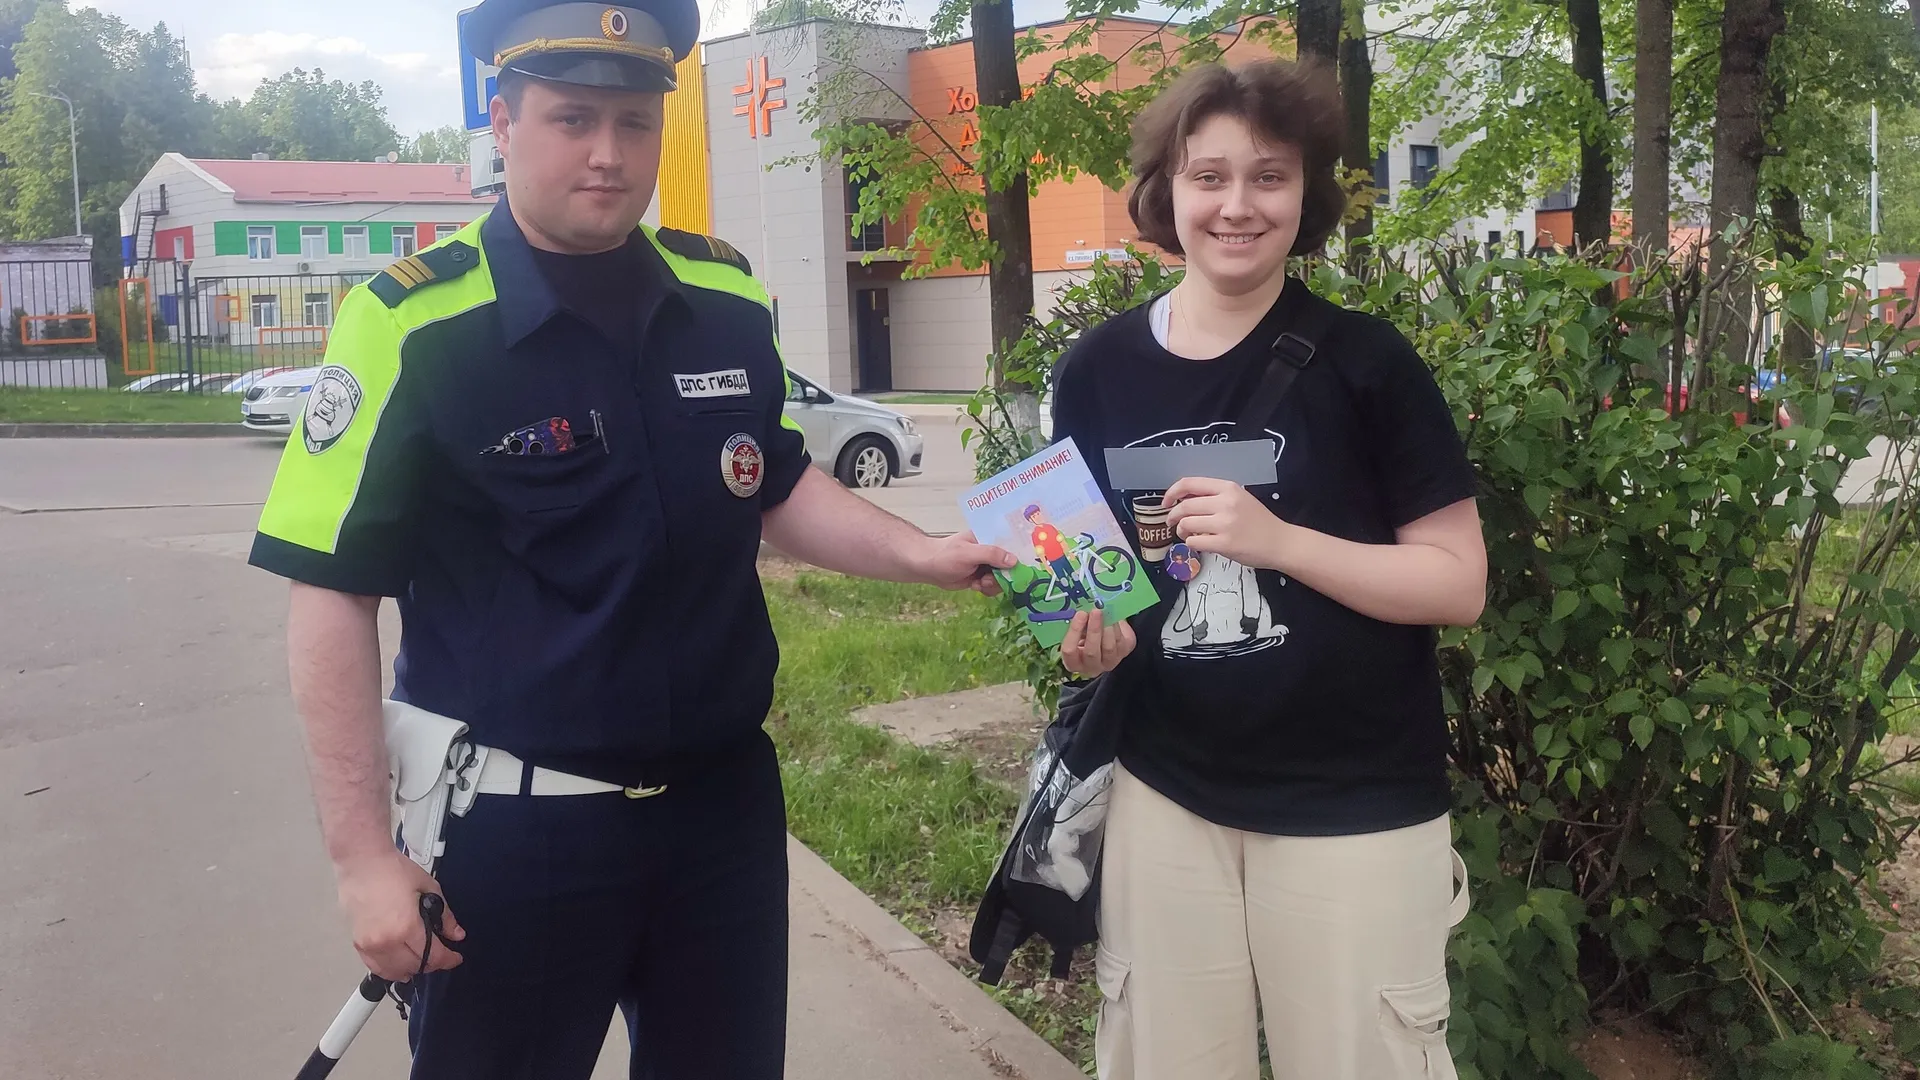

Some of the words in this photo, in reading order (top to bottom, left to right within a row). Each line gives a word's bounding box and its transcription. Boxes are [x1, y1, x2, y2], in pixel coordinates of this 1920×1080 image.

[680, 378, 706, 393] ДПС
[708, 373, 748, 390] ГИБДД
[727, 434, 761, 452] ПОЛИЦИЯ
[966, 476, 1020, 511] РОДИТЕЛИ!
[1018, 448, 1073, 485] ВНИМАНИЕ!
[1139, 526, 1173, 542] COFFEE
